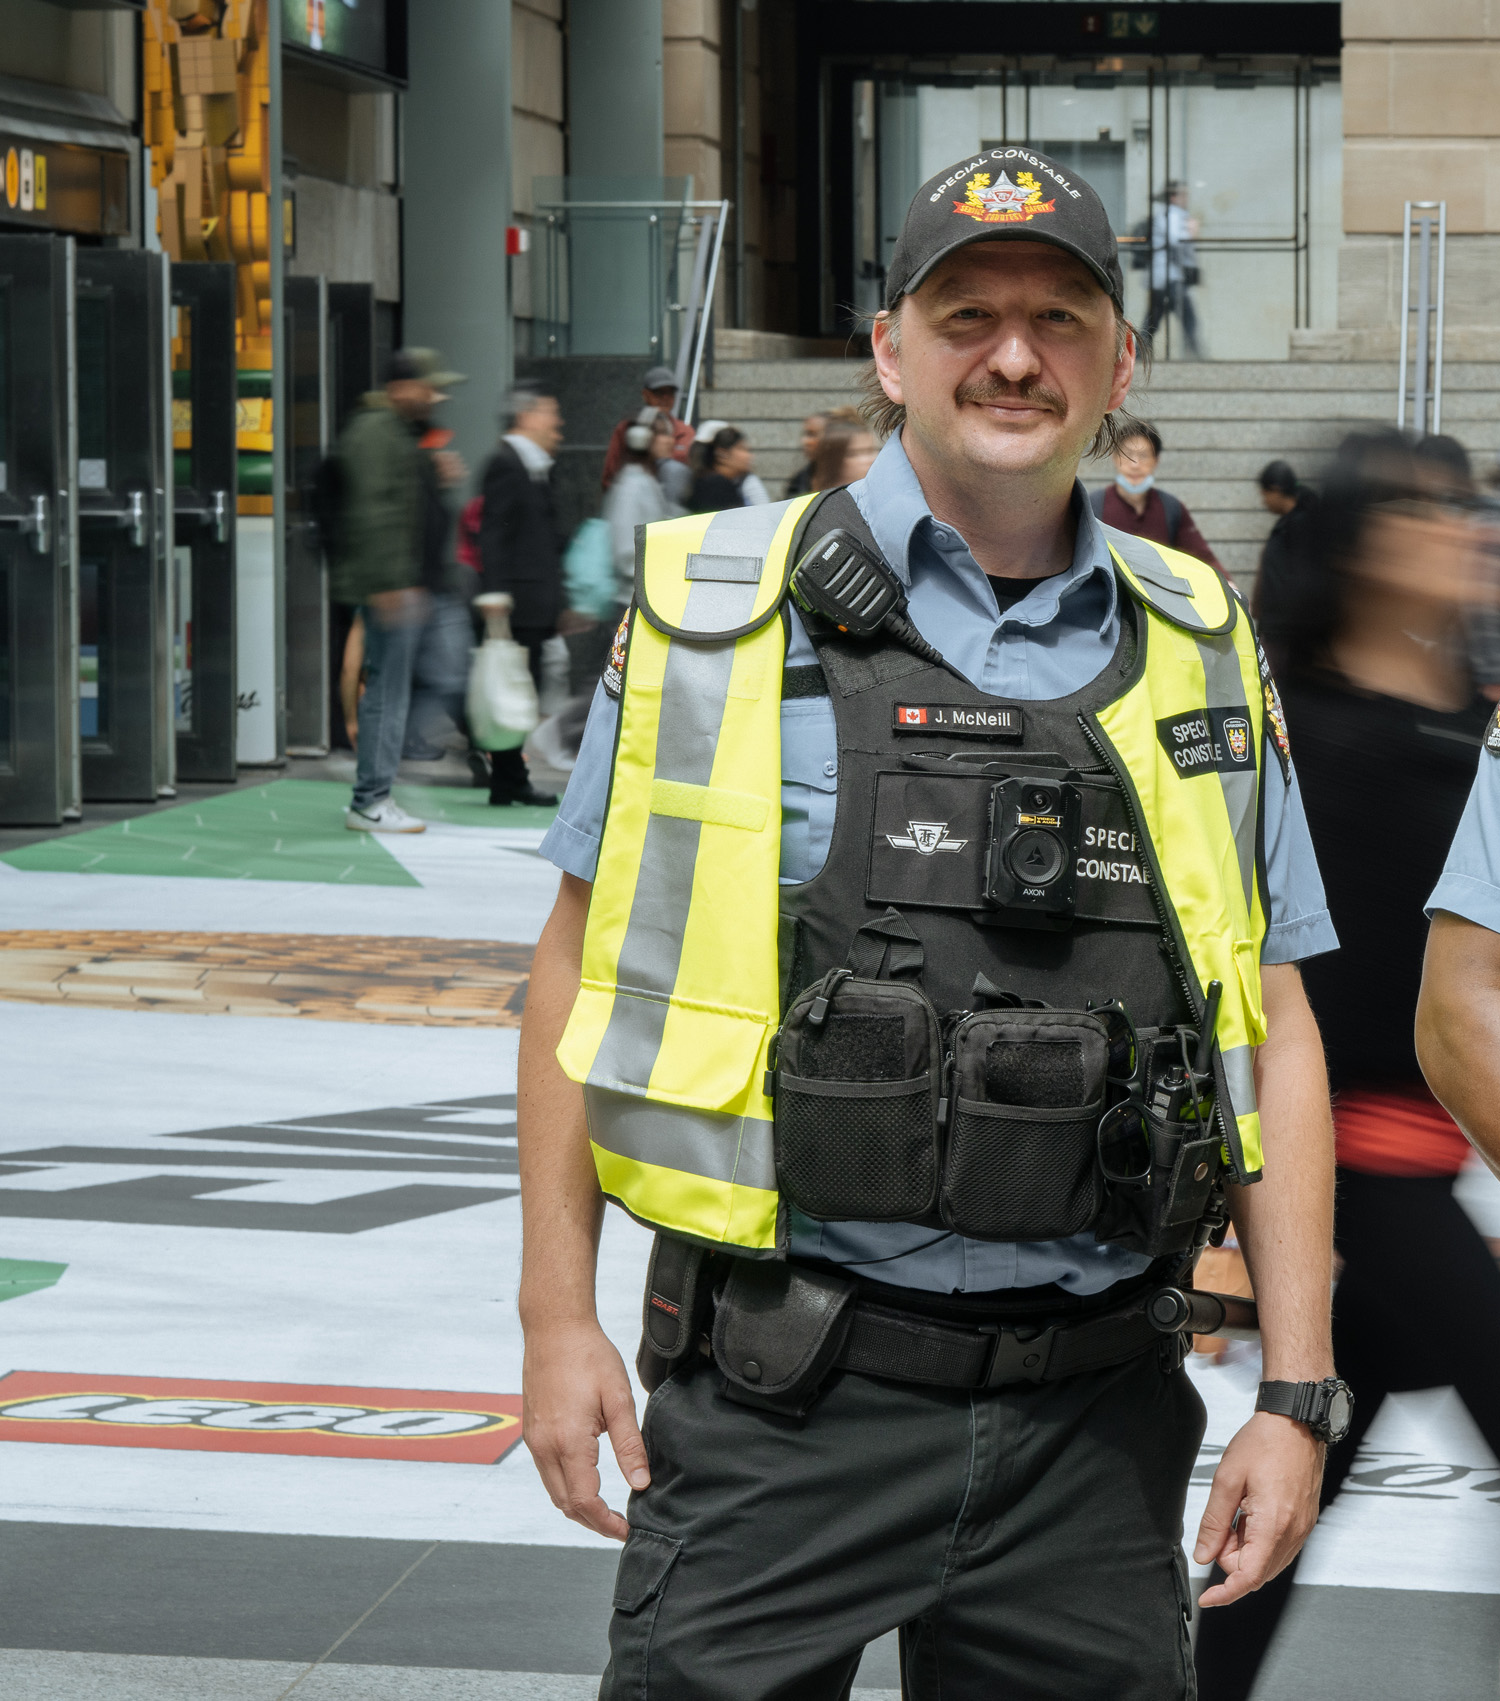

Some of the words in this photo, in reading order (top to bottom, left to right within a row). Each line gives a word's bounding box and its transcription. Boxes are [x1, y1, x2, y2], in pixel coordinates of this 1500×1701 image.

[930, 158, 988, 203] SPECIAL
[991, 149, 1082, 200] CONSTABLE
[935, 711, 948, 724] J.
[953, 711, 1011, 727] McNeill
[1172, 720, 1211, 743] SPECI
[1022, 888, 1045, 896] AXON
[1, 1394, 490, 1436] LEGO
